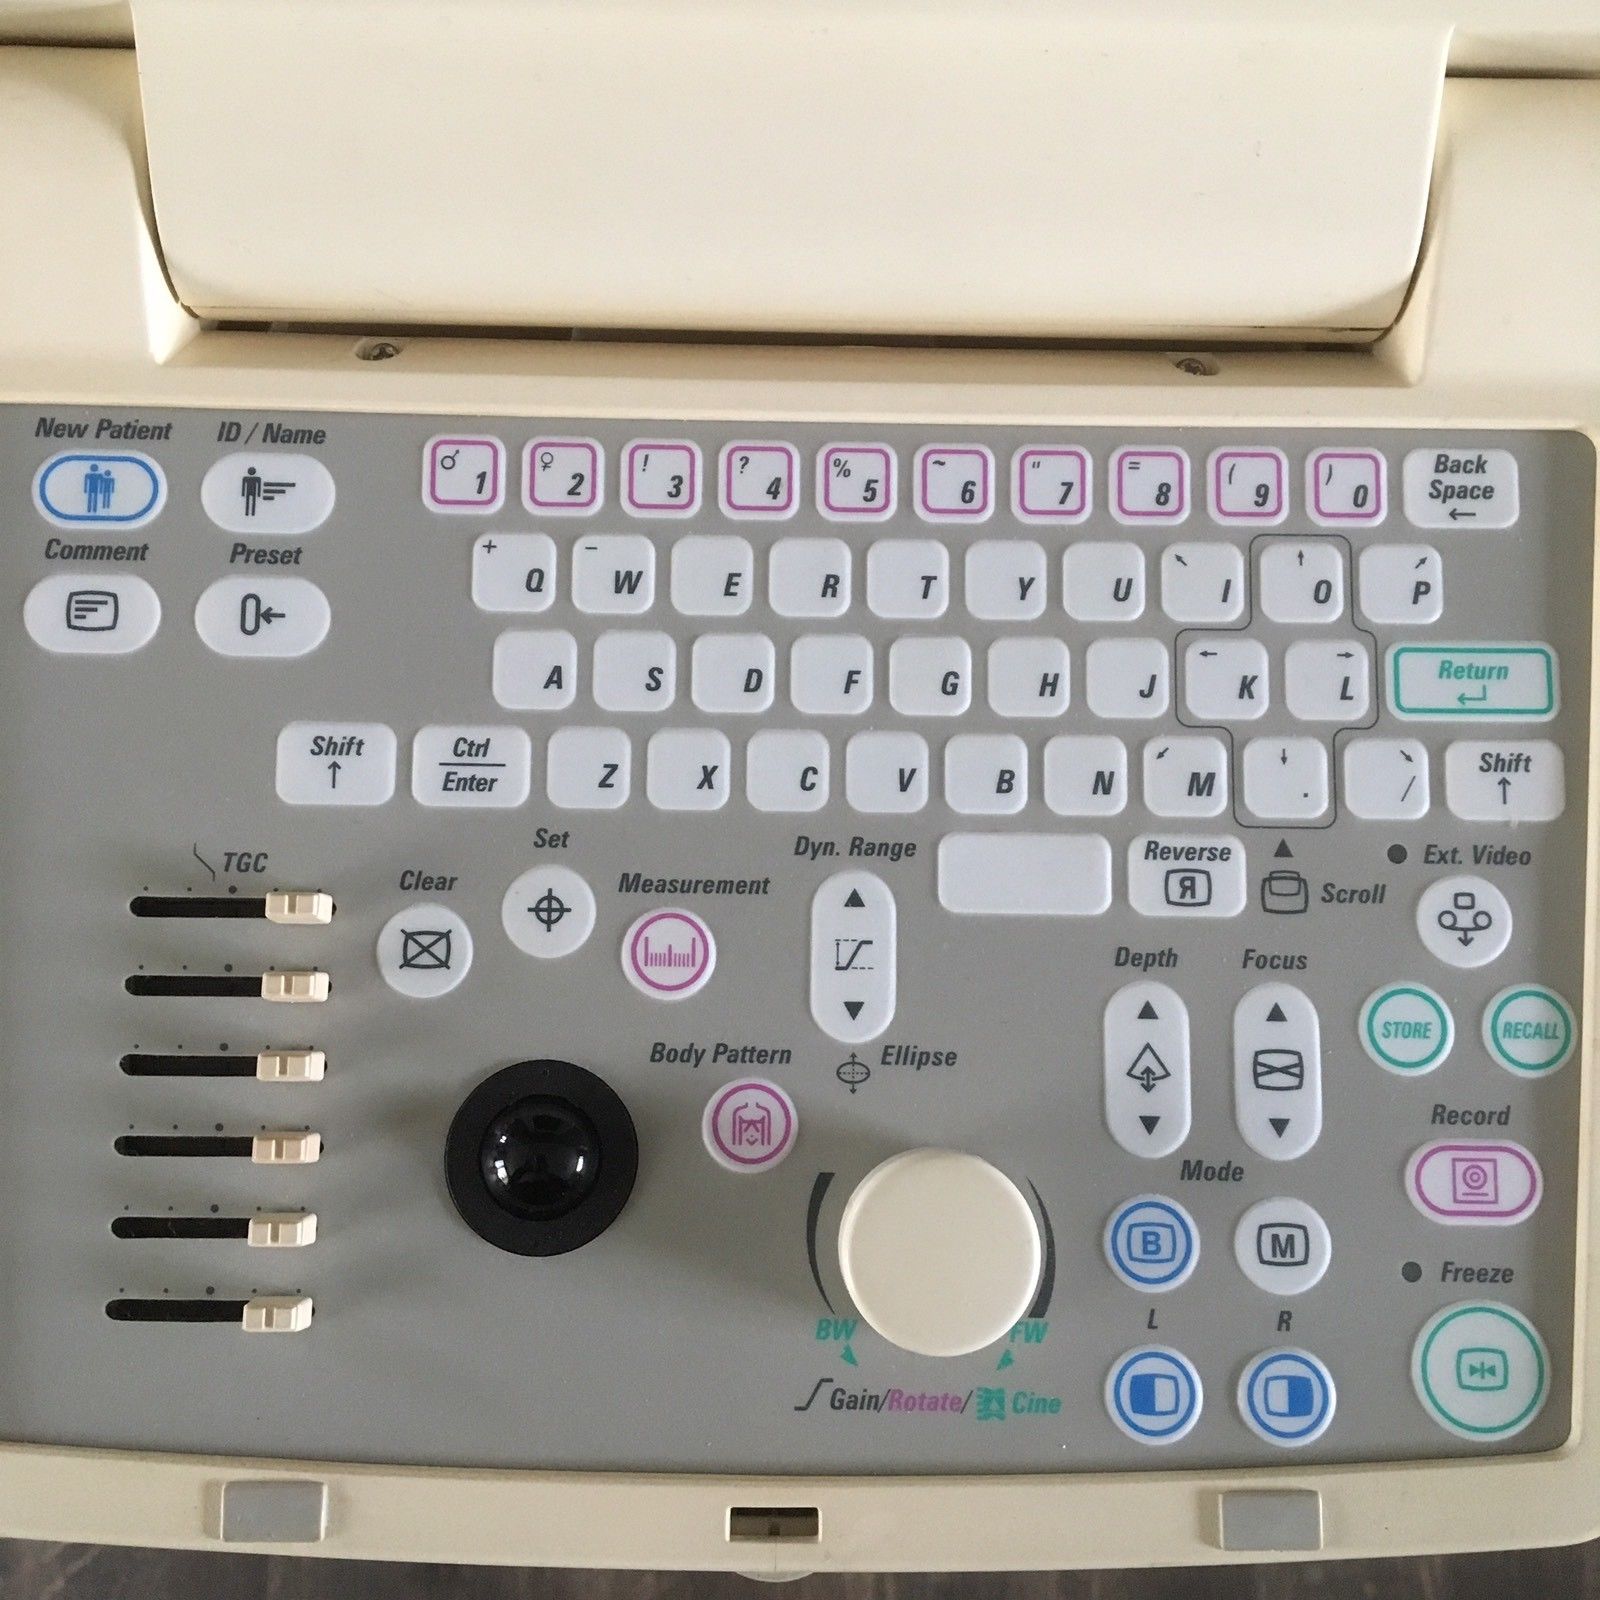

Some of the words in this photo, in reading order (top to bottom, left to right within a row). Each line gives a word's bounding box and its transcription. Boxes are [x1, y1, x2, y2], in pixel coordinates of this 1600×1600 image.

[35, 417, 89, 438] New
[95, 419, 172, 440] Patient
[217, 422, 241, 442] ID
[243, 421, 260, 445] /
[262, 423, 326, 444] Name
[1434, 454, 1487, 474] Back
[567, 473, 584, 496] 2
[667, 475, 683, 498] 3
[766, 477, 781, 500] 4
[863, 479, 878, 502] 5
[961, 481, 976, 504] 6
[1059, 482, 1073, 504] 7
[1156, 483, 1171, 506] 8
[1254, 484, 1269, 507] 9
[1429, 480, 1494, 503] Space
[45, 539, 149, 561] Comment
[230, 543, 302, 564] Preset
[526, 568, 544, 592] Q
[615, 571, 643, 594] W
[724, 573, 741, 596] E
[821, 574, 840, 597] R
[921, 576, 937, 599] T
[1019, 577, 1035, 600] Y
[1113, 578, 1132, 602] U
[1413, 581, 1430, 604] P
[543, 666, 562, 689] A
[646, 667, 663, 691] S
[744, 669, 762, 692] D
[1439, 660, 1508, 680] Return
[844, 670, 861, 694] F
[941, 671, 959, 695] G
[1039, 673, 1059, 696] H
[1139, 675, 1156, 698] J
[1239, 675, 1258, 699] K
[1340, 677, 1353, 700] L
[310, 736, 364, 756] Shift
[453, 737, 490, 757] Ctrl
[1479, 752, 1532, 772] Shift
[442, 772, 498, 792] Enter
[598, 764, 618, 788] Z
[697, 766, 718, 789] X
[800, 767, 818, 791] C
[899, 768, 916, 792] V
[996, 770, 1015, 793] B
[1093, 771, 1114, 795] N
[1188, 772, 1215, 796] M
[534, 828, 570, 848] Set
[794, 836, 839, 860] Dyn.
[849, 837, 916, 861] Range
[224, 852, 268, 873] TGC
[1145, 841, 1231, 861] Reverse
[1424, 844, 1462, 864] Ext.
[1473, 845, 1531, 865] Video
[400, 870, 458, 890] Clear
[619, 873, 770, 894] Measurement
[1321, 883, 1386, 904] Scroll
[1115, 947, 1178, 972] Depth
[1242, 949, 1307, 969] Focus
[1382, 1022, 1432, 1039] STORE
[1502, 1021, 1560, 1040] RECALL
[650, 1043, 706, 1068] Body
[712, 1043, 791, 1064] Pattern
[881, 1045, 957, 1070] Ellipse
[1431, 1104, 1511, 1125] Record
[1180, 1160, 1243, 1181] Mode
[1142, 1232, 1162, 1257] B
[1271, 1234, 1296, 1259] M
[1441, 1262, 1514, 1283] Freeze
[815, 1318, 858, 1341] BW
[1148, 1309, 1158, 1329] L
[1277, 1311, 1292, 1331] R
[1009, 1322, 1049, 1344] FW
[1013, 1391, 1062, 1414] Cine
